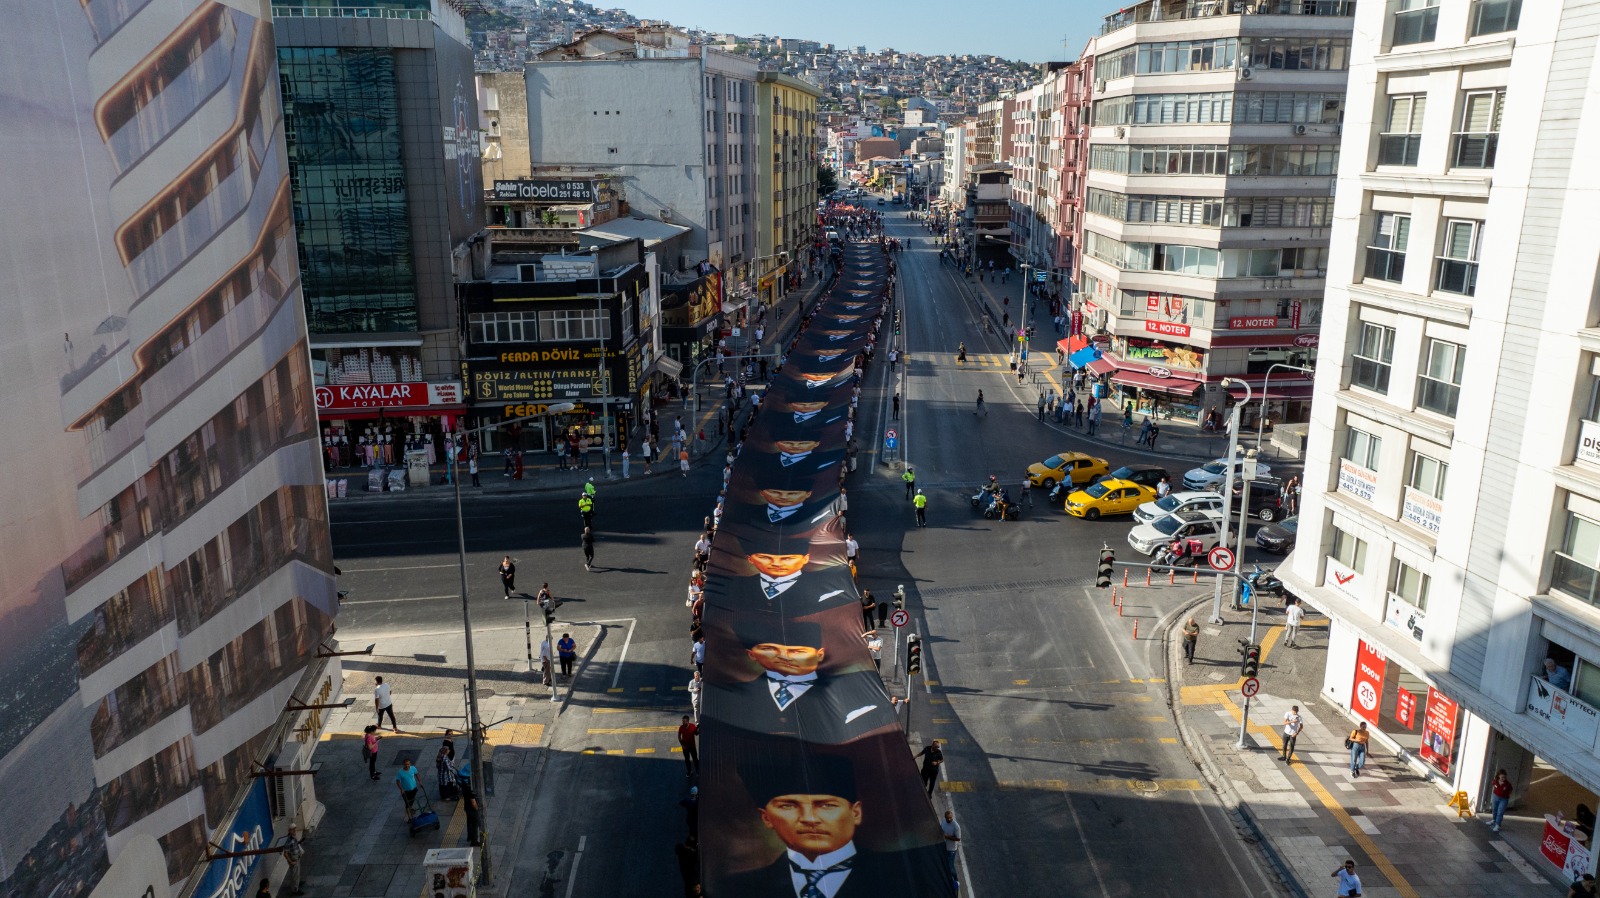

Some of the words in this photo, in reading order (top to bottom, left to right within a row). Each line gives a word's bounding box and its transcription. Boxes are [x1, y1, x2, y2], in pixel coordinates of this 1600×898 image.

[495, 182, 517, 192] Şahin
[518, 183, 558, 198] Tabela
[572, 182, 584, 190] 533
[582, 190, 590, 198] 13
[1147, 322, 1158, 331] 12.
[1160, 323, 1186, 335] NOTER
[1245, 319, 1275, 327] NOTER
[501, 351, 539, 363] FERDA
[542, 348, 580, 361] DÖVİZ
[461, 362, 471, 396] ALTIN
[475, 371, 511, 381] DÖVİZ
[628, 359, 636, 388] FERDA
[340, 385, 411, 400] KAYALAR
[505, 404, 562, 417] FERD
[1342, 482, 1354, 492] 445
[1354, 487, 1359, 495] 2
[1359, 490, 1372, 500] 579
[1408, 513, 1421, 524] 445
[1361, 663, 1375, 678] 1000
[1361, 685, 1374, 702] 215
[1363, 699, 1370, 708] TL
[1570, 698, 1597, 717] HYTECH
